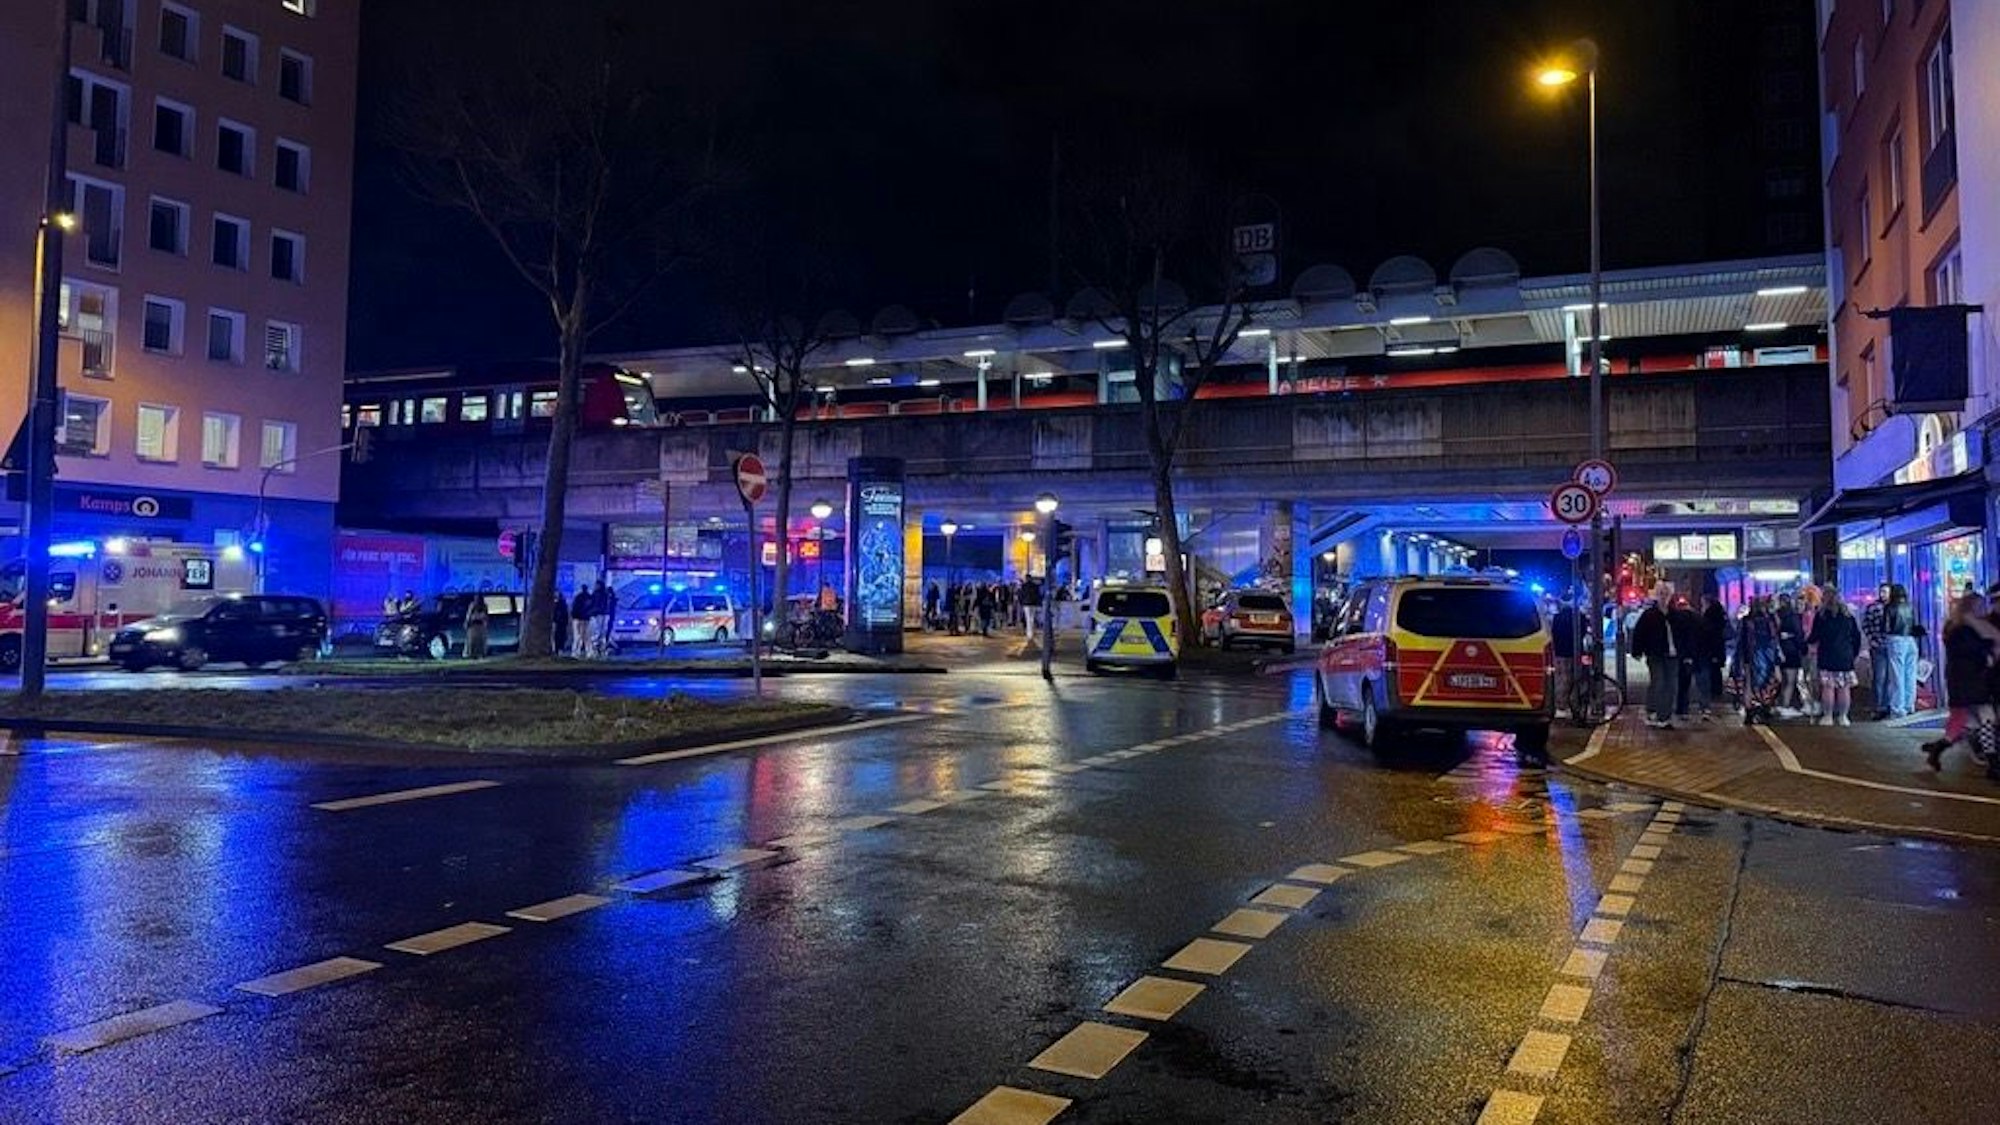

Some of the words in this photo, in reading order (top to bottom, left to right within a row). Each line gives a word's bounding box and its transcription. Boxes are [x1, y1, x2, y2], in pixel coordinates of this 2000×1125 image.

[1239, 228, 1270, 248] DB
[80, 495, 131, 512] Kamps
[1561, 494, 1586, 513] 30
